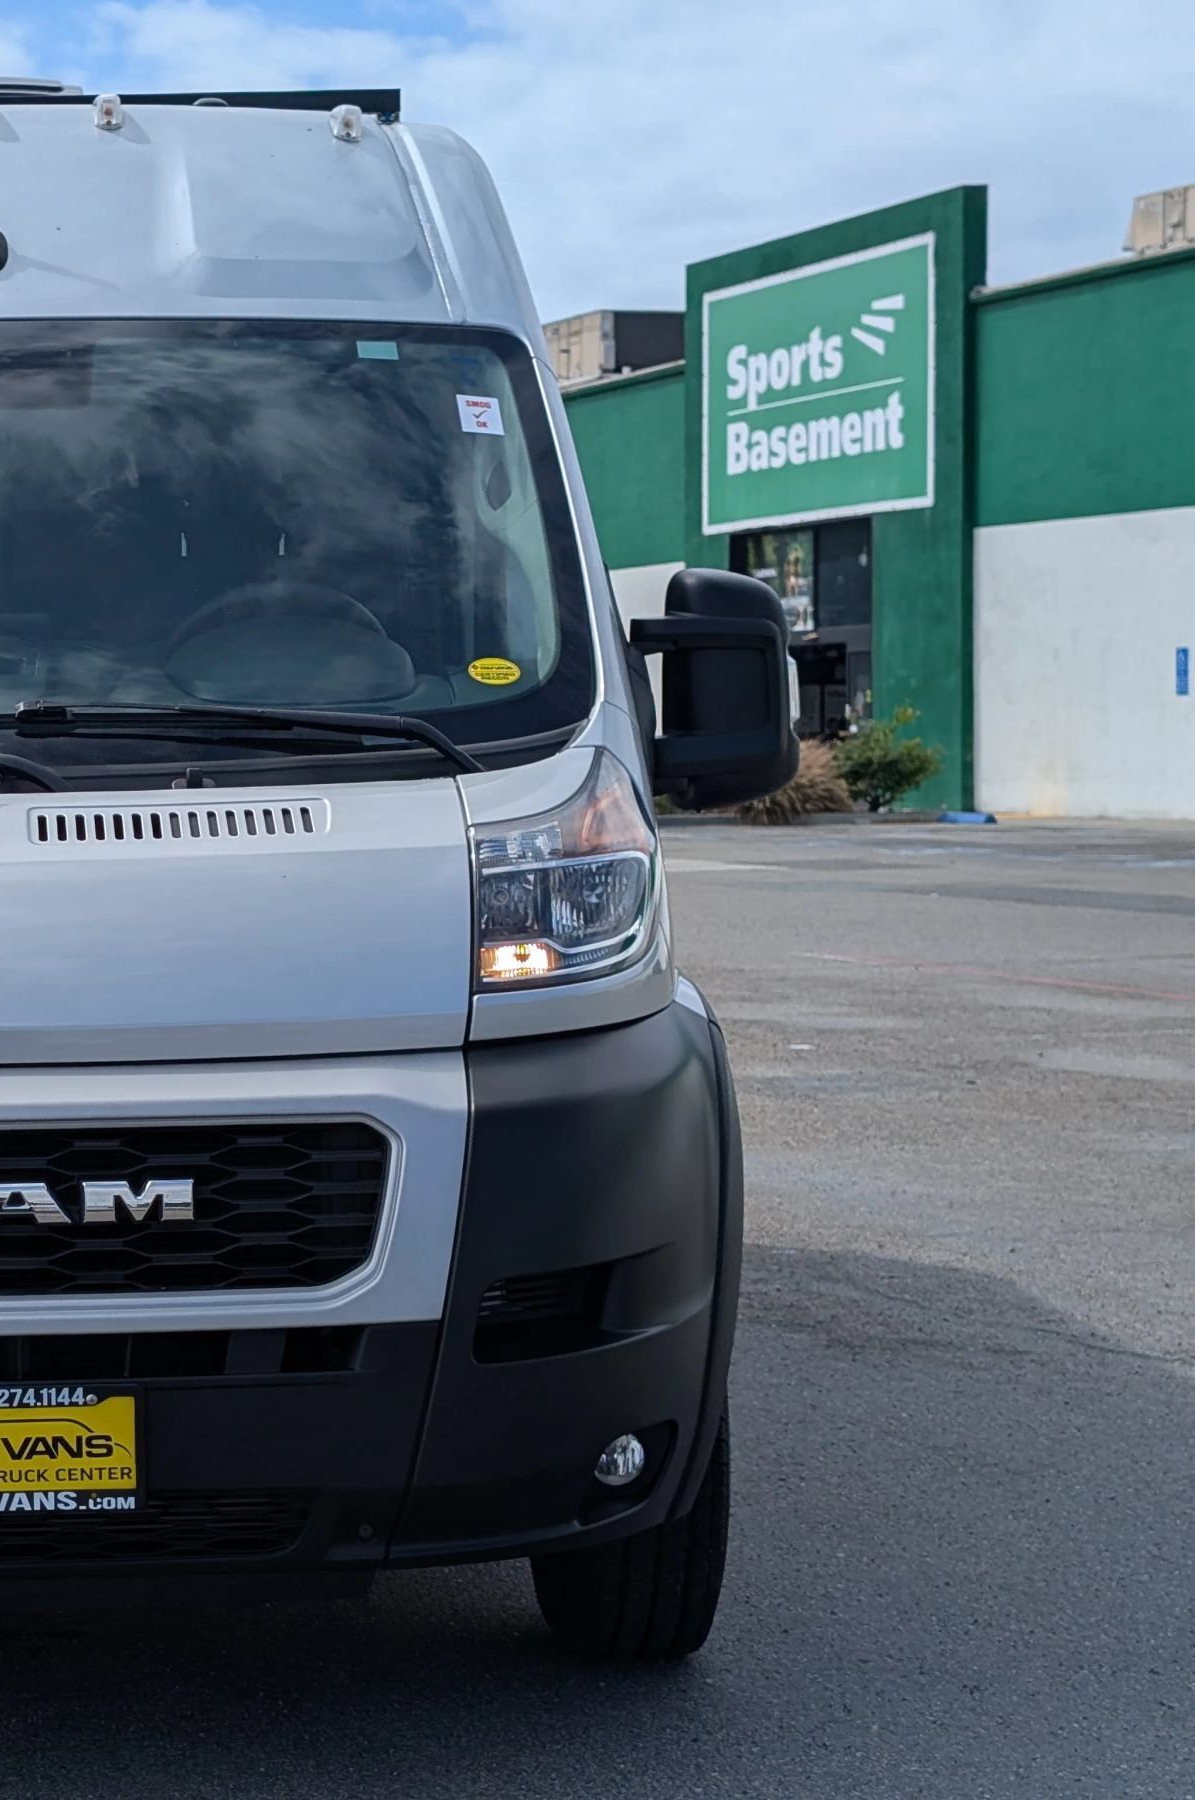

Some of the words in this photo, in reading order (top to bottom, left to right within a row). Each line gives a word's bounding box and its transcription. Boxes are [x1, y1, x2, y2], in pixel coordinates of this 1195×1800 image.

[726, 326, 844, 411] Sports
[476, 420, 489, 429] OK
[726, 391, 905, 476] Basement
[55, 1466, 133, 1482] CENTER
